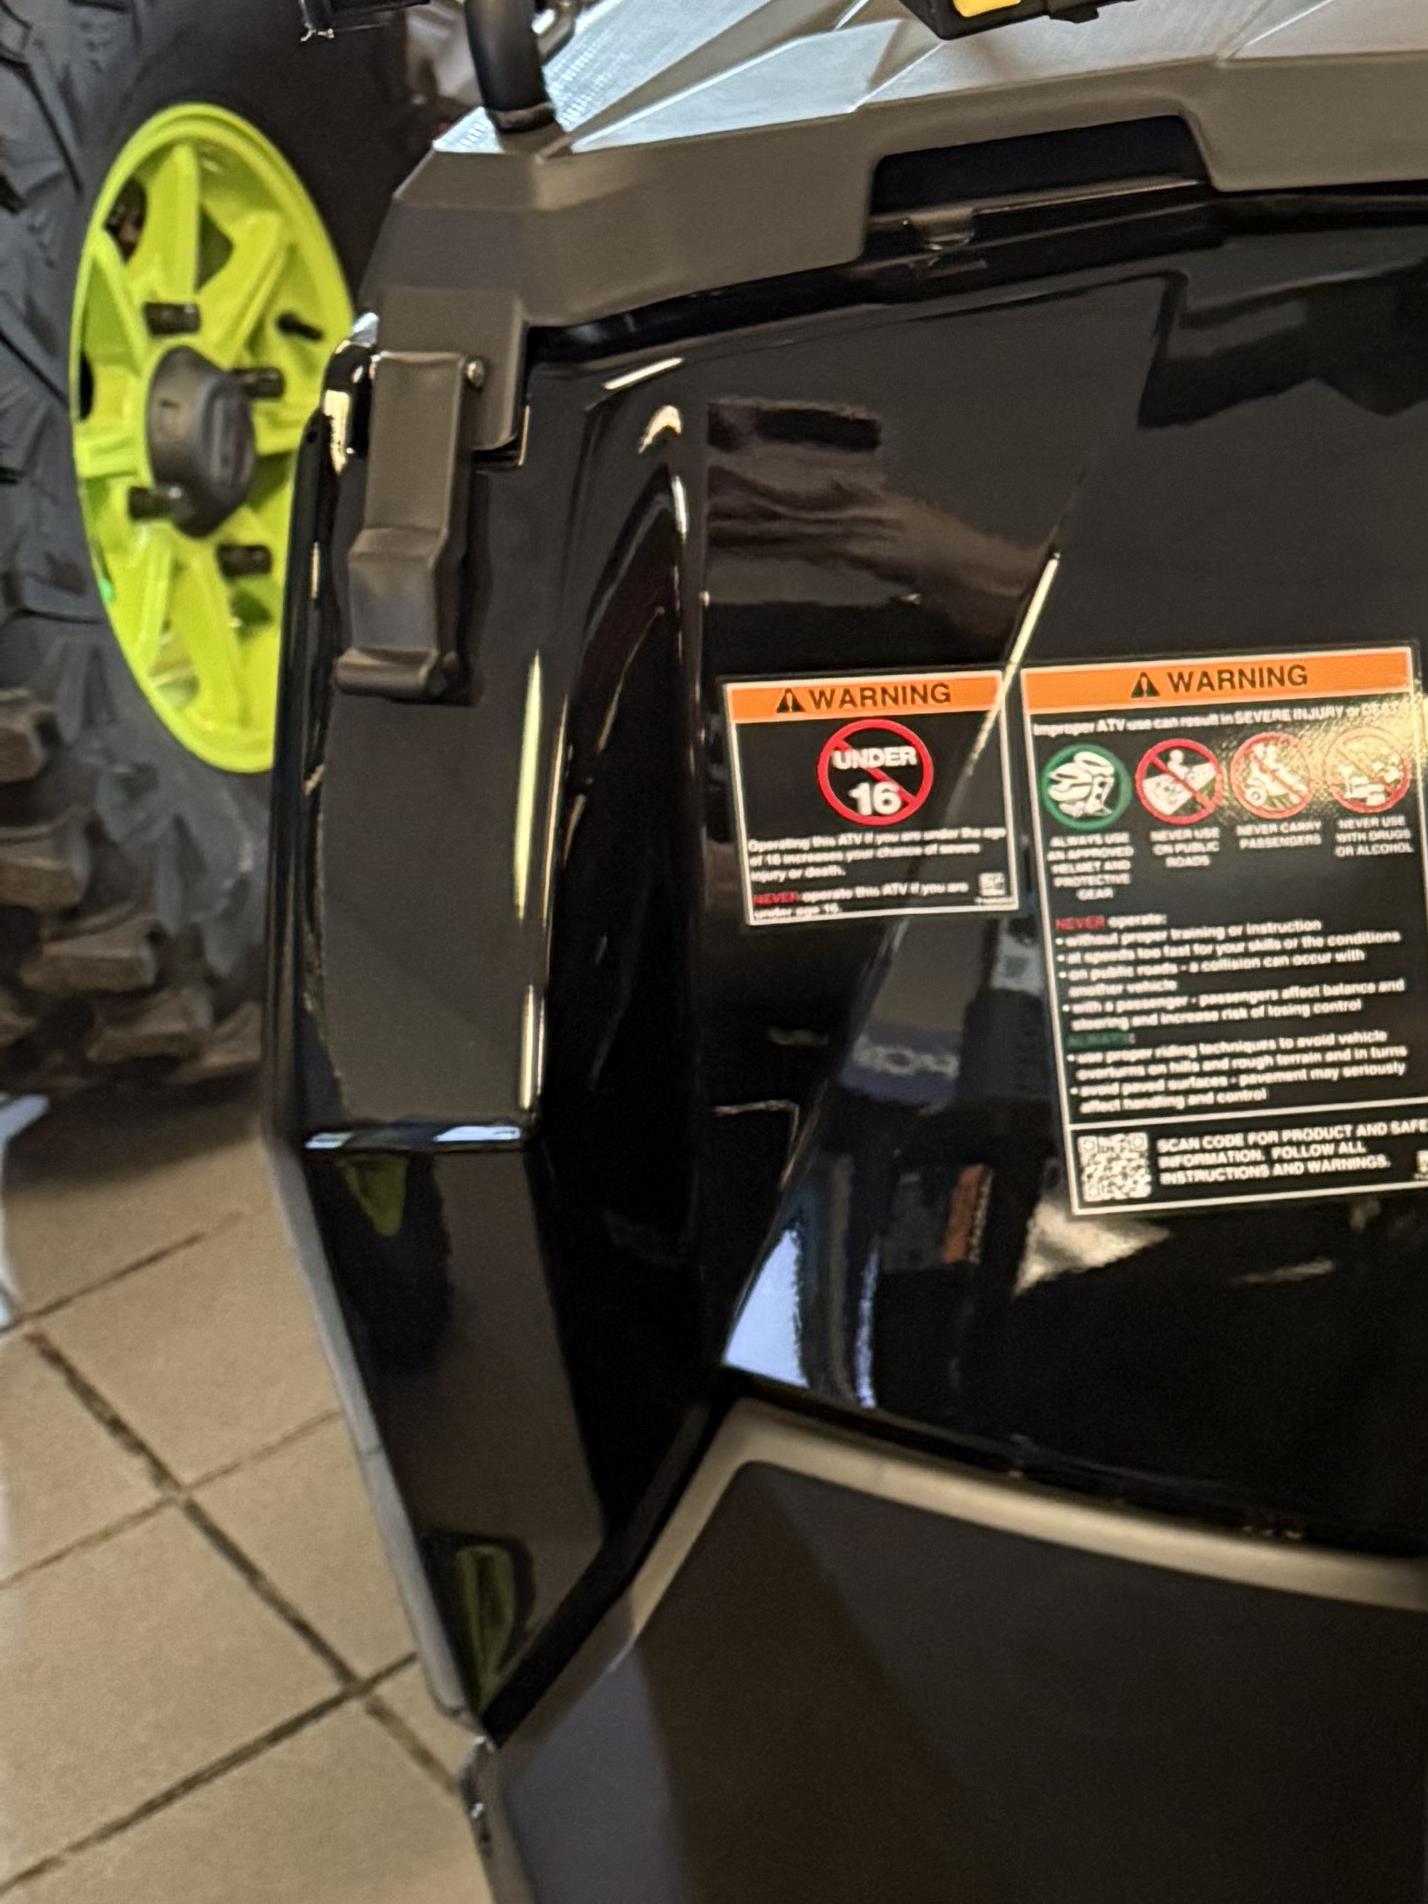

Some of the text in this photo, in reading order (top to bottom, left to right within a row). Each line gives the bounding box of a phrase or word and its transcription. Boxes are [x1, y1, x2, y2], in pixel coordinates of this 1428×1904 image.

[1167, 665, 1308, 694] WARNING
[809, 683, 951, 711] WARNING
[1097, 717, 1124, 733] ATV
[1234, 708, 1290, 725] SEVERE
[1293, 705, 1343, 722] INJURY
[832, 746, 917, 769] UNDER
[849, 781, 902, 816] 16
[1236, 823, 1278, 837] NEVER
[1338, 816, 1379, 830] NEVER
[1335, 830, 1366, 842] WITH
[1356, 842, 1411, 856] ALCOHOL
[1216, 1089, 1266, 1104] control
[1157, 1137, 1200, 1153] SCAN
[1201, 1133, 1244, 1150] CODE
[1247, 1131, 1278, 1146] FOR
[1281, 1125, 1352, 1144] PRODUCT
[1356, 1123, 1387, 1138] AND
[1271, 1142, 1335, 1160] FOLLOW
[1337, 1140, 1365, 1155] ALL
[1272, 1162, 1304, 1177] AND
[1307, 1156, 1390, 1174] WARNINGS.
